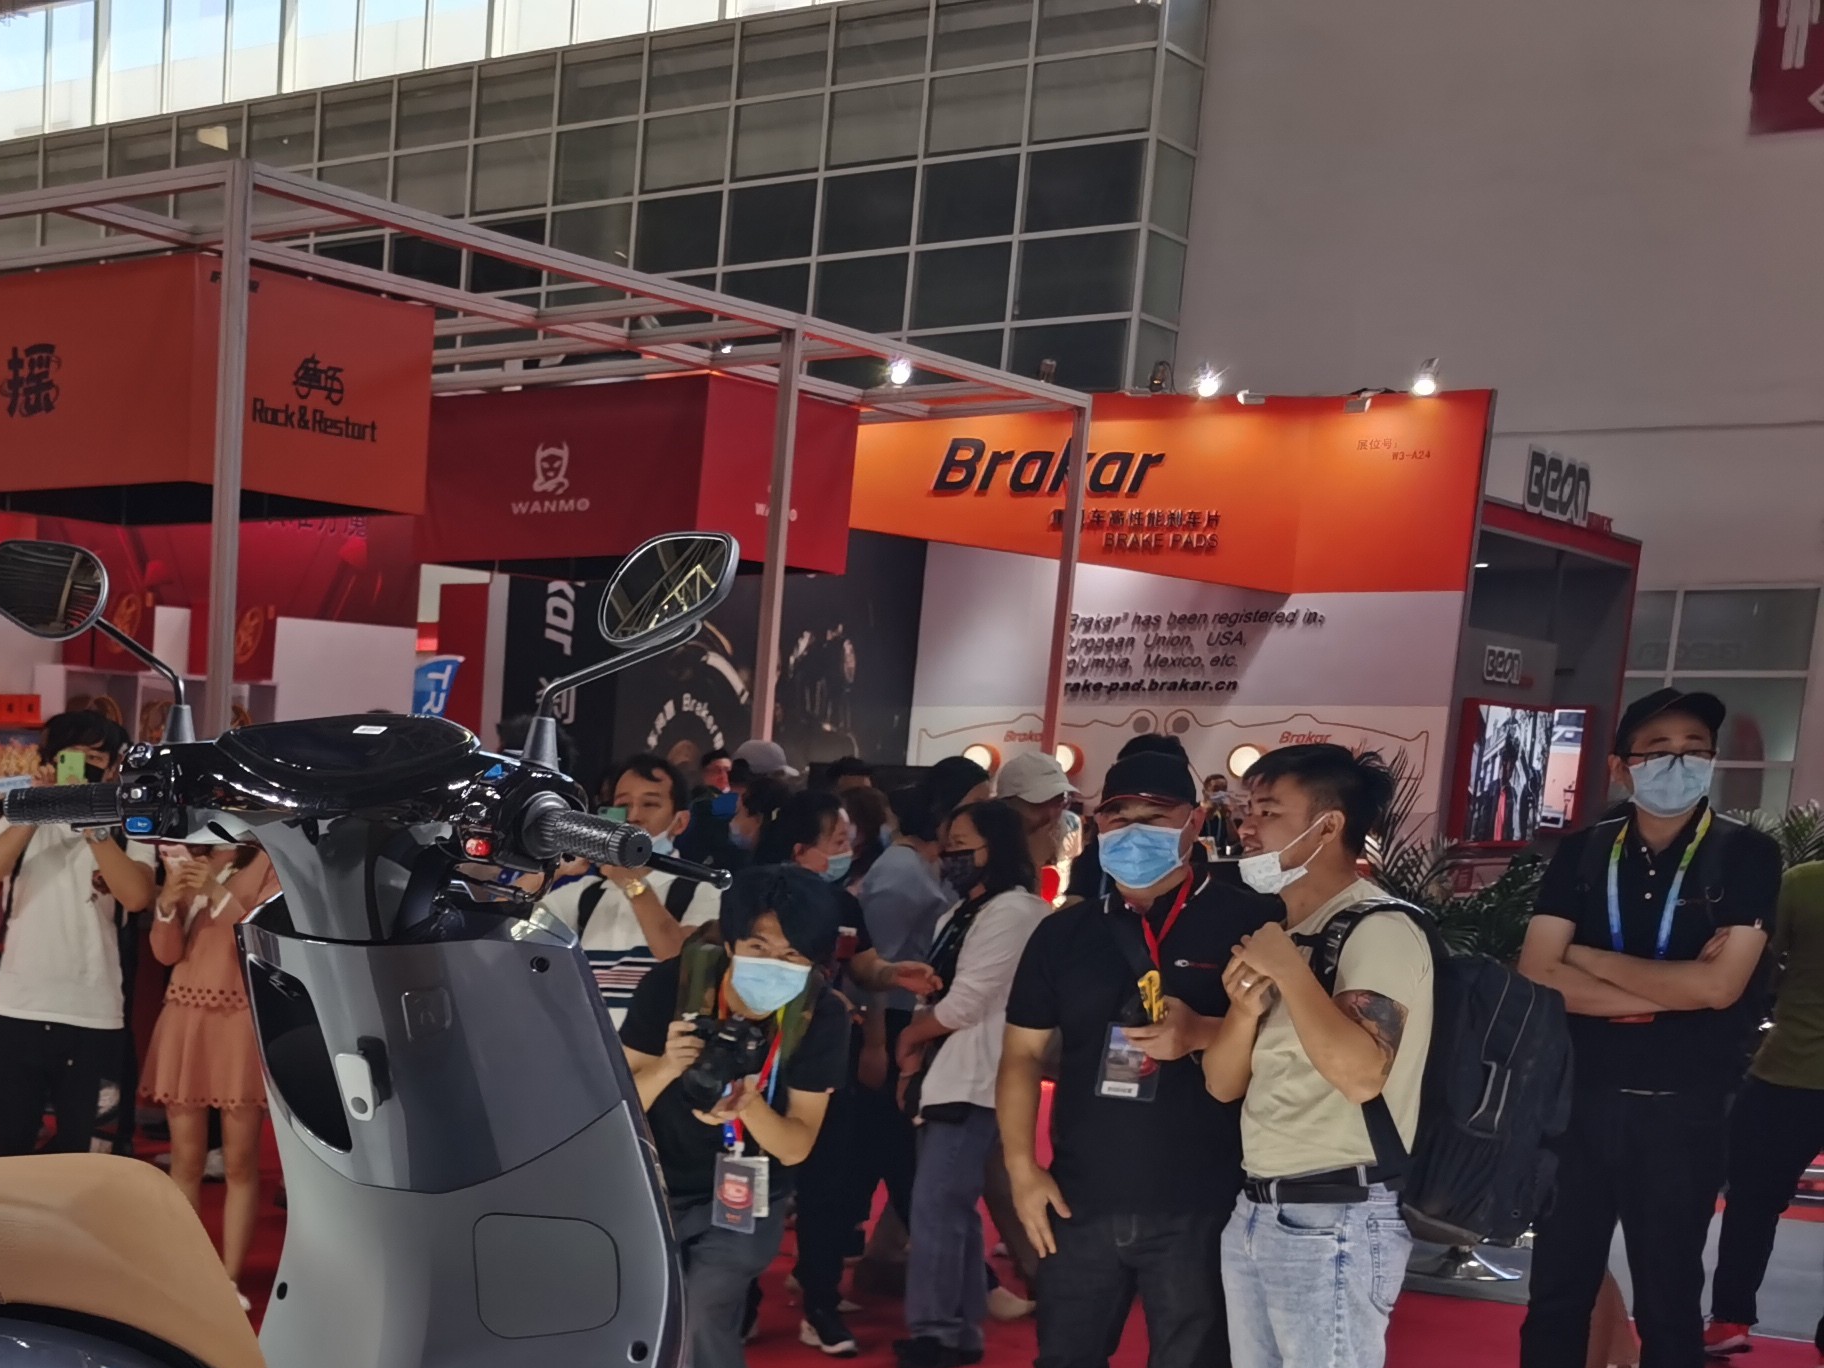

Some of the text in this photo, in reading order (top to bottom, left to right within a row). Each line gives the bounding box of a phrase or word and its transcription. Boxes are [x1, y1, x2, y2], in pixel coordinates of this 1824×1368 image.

[1391, 450, 1431, 461] W3-A24
[511, 497, 591, 515] WANMO
[1103, 533, 1219, 548] BRAKE PADS
[1131, 611, 1162, 628] has
[1167, 611, 1208, 627] been
[1212, 608, 1300, 628] registered
[1068, 635, 1135, 654] uropean
[1206, 630, 1247, 647] USA,
[1063, 678, 1239, 695] rake-pad.brakar.cn
